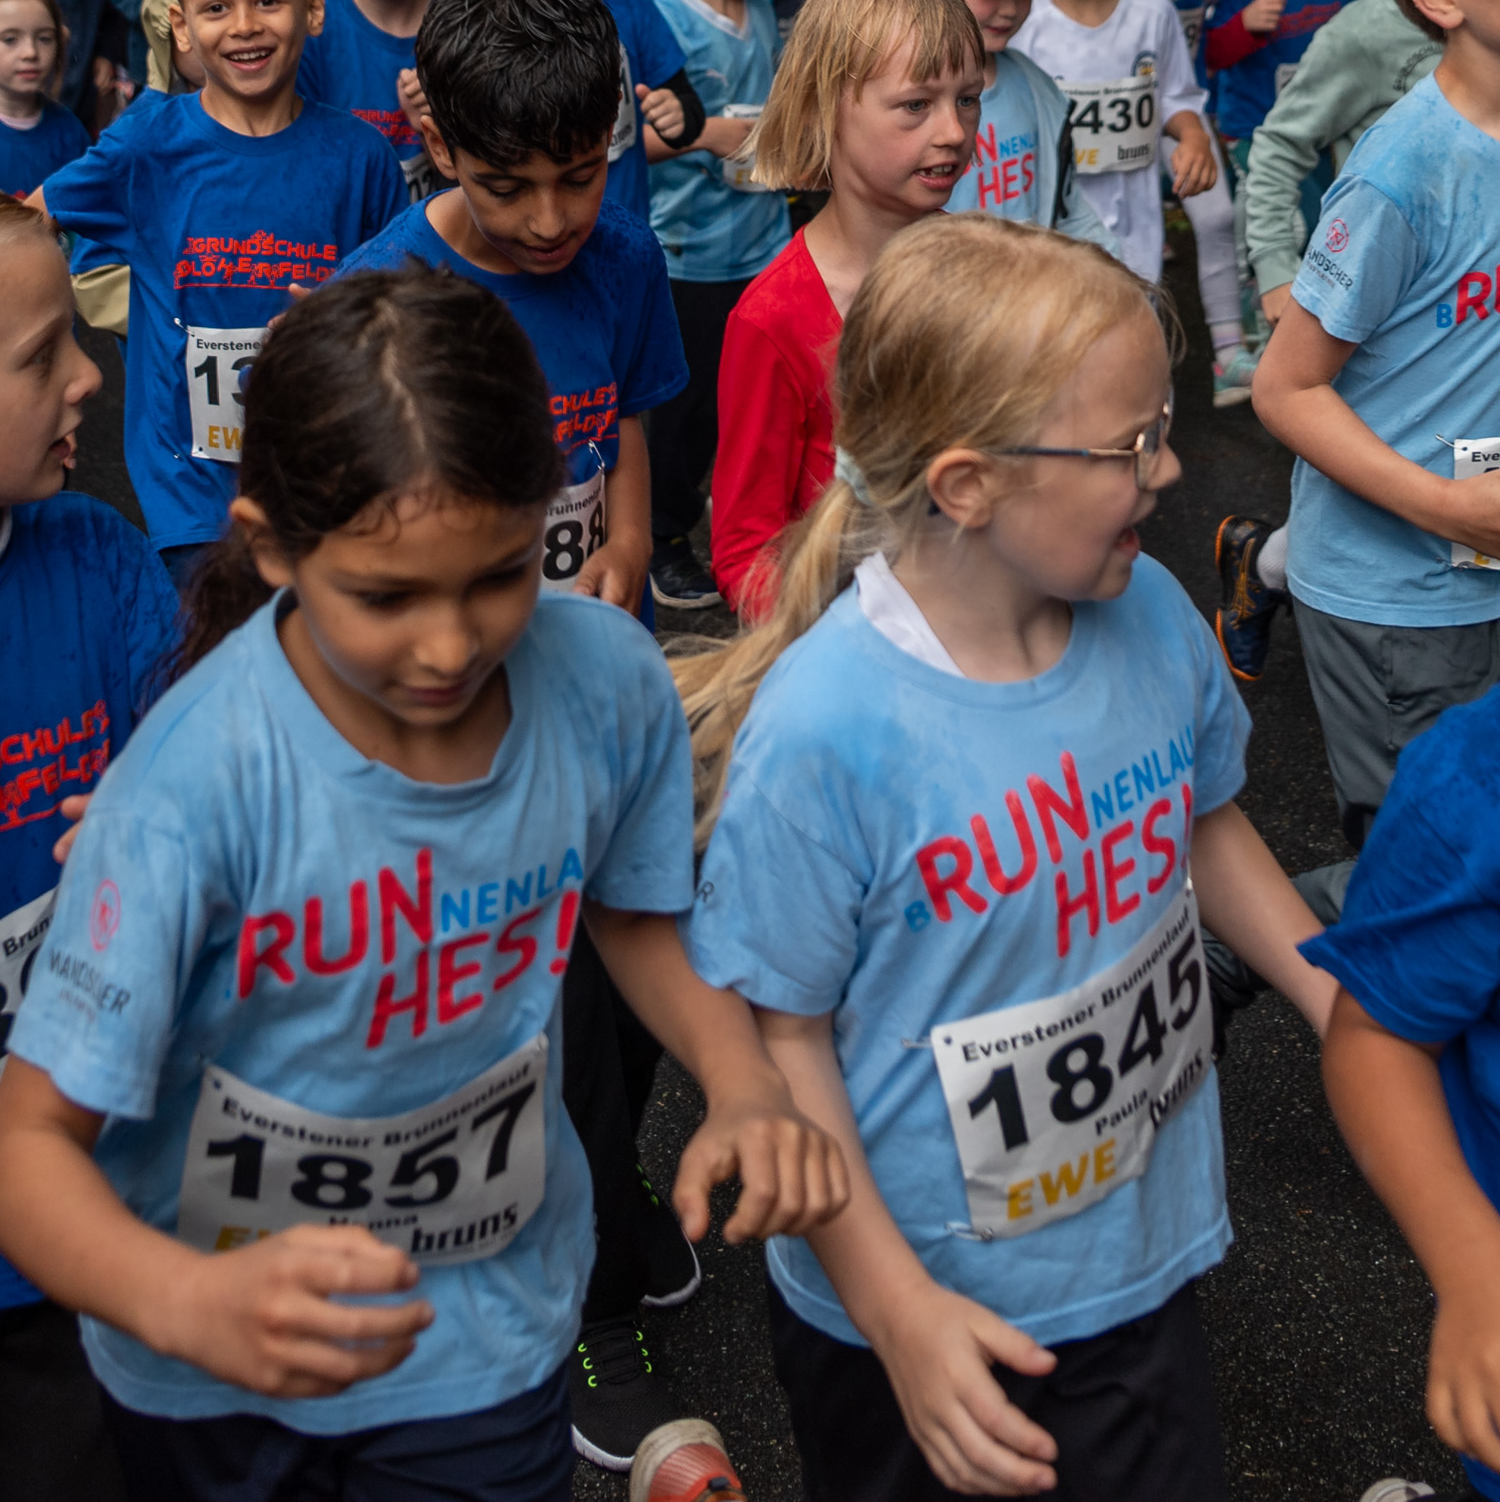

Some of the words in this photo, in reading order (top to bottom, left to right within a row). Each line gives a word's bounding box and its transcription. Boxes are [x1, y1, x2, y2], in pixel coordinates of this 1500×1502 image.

[366, 890, 582, 1050] HES!
[961, 1000, 1097, 1064] Everstener
[1101, 904, 1191, 1011] Brunnenlauf
[968, 927, 1200, 1153] 1845
[205, 1080, 538, 1212] 1857
[221, 1095, 375, 1150] Everstener
[383, 1061, 532, 1148] Brunnenlauf
[1095, 1089, 1149, 1136] Paula
[328, 1214, 418, 1232] Hnna
[1007, 1138, 1117, 1222] EWE
[410, 1202, 520, 1254] bruns
